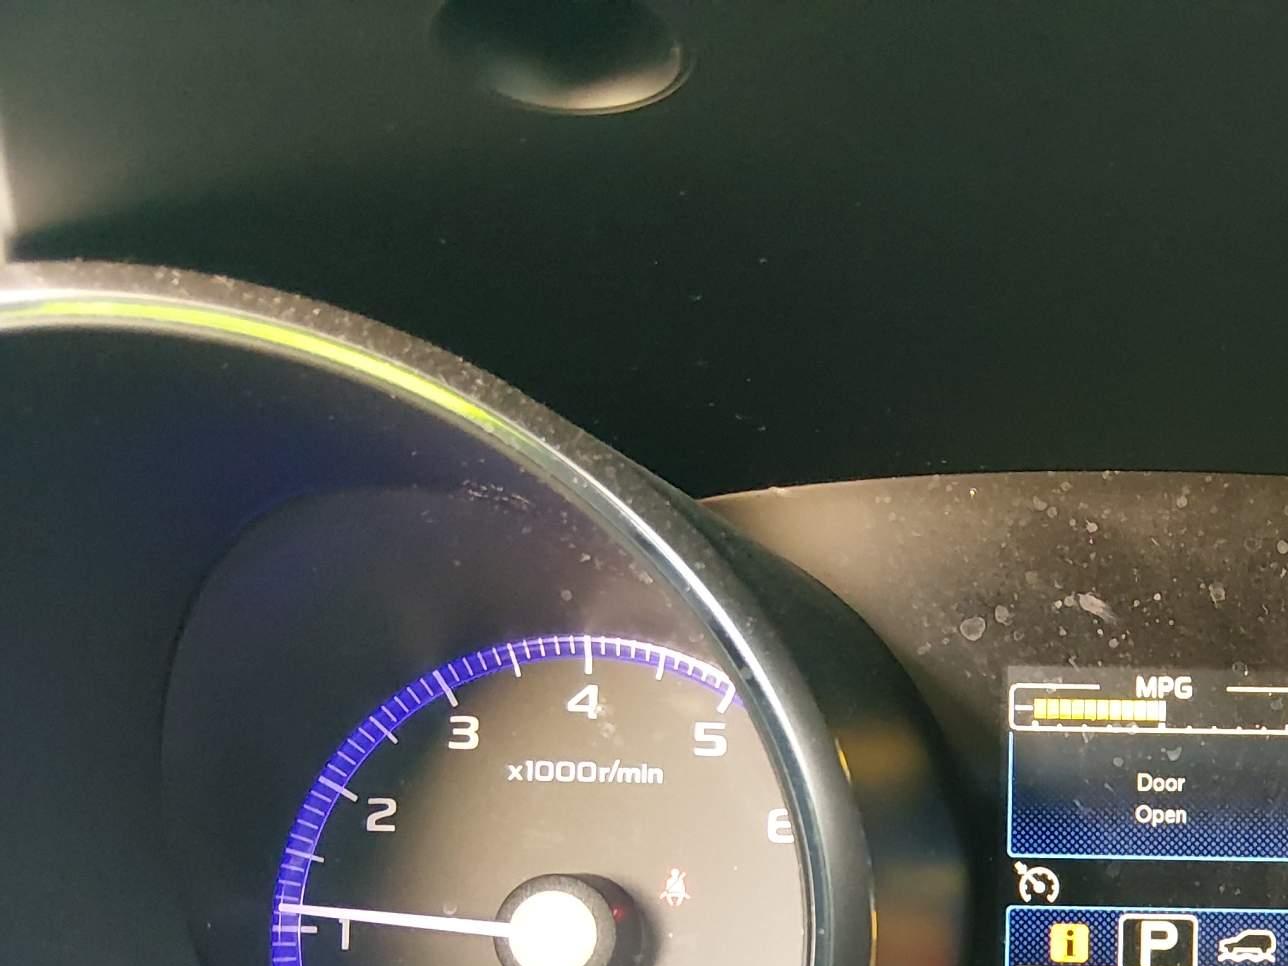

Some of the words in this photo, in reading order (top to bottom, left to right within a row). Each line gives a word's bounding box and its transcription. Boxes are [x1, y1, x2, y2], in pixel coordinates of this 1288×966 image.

[567, 684, 601, 720] 4
[1135, 677, 1193, 699] MPG
[448, 716, 479, 749] 3
[693, 722, 728, 757] 5
[507, 759, 664, 786] x1000r/min
[1137, 773, 1186, 793] Door
[367, 798, 396, 832] 2
[1134, 805, 1188, 826] Open
